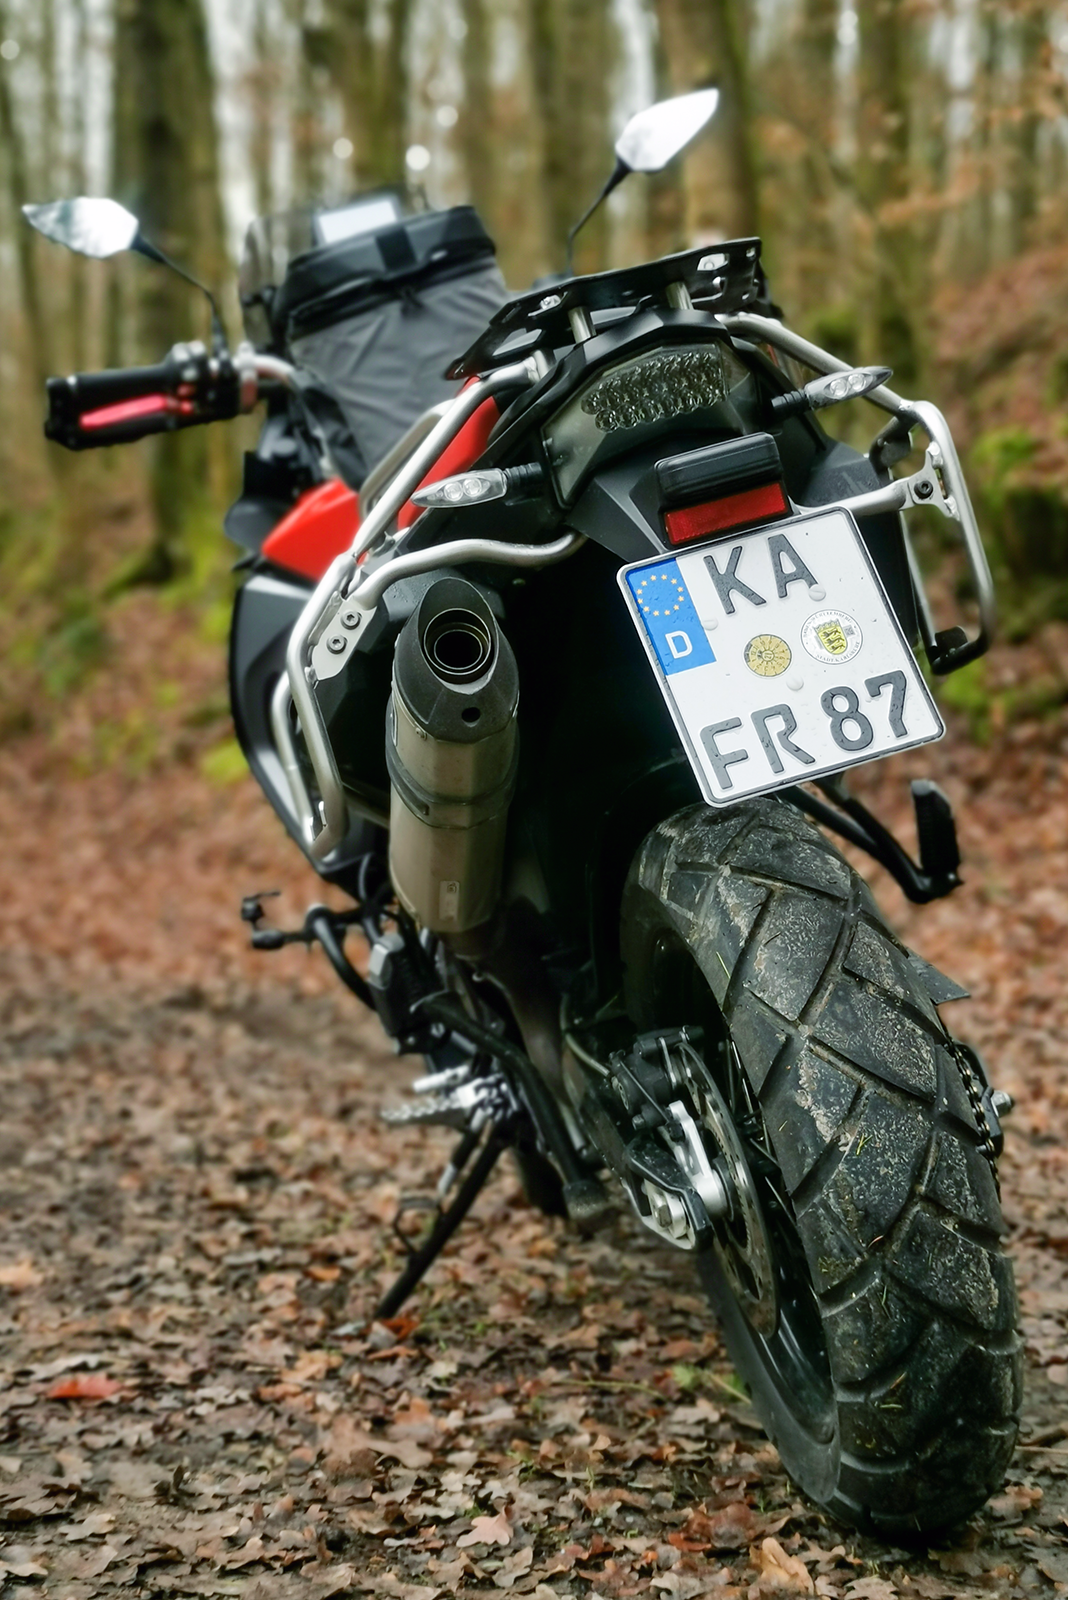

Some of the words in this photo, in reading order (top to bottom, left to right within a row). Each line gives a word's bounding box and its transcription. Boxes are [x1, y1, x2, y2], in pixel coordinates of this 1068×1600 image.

[703, 533, 819, 615] KA
[664, 630, 693, 659] D
[700, 703, 815, 790] FR
[820, 669, 908, 751] 87
